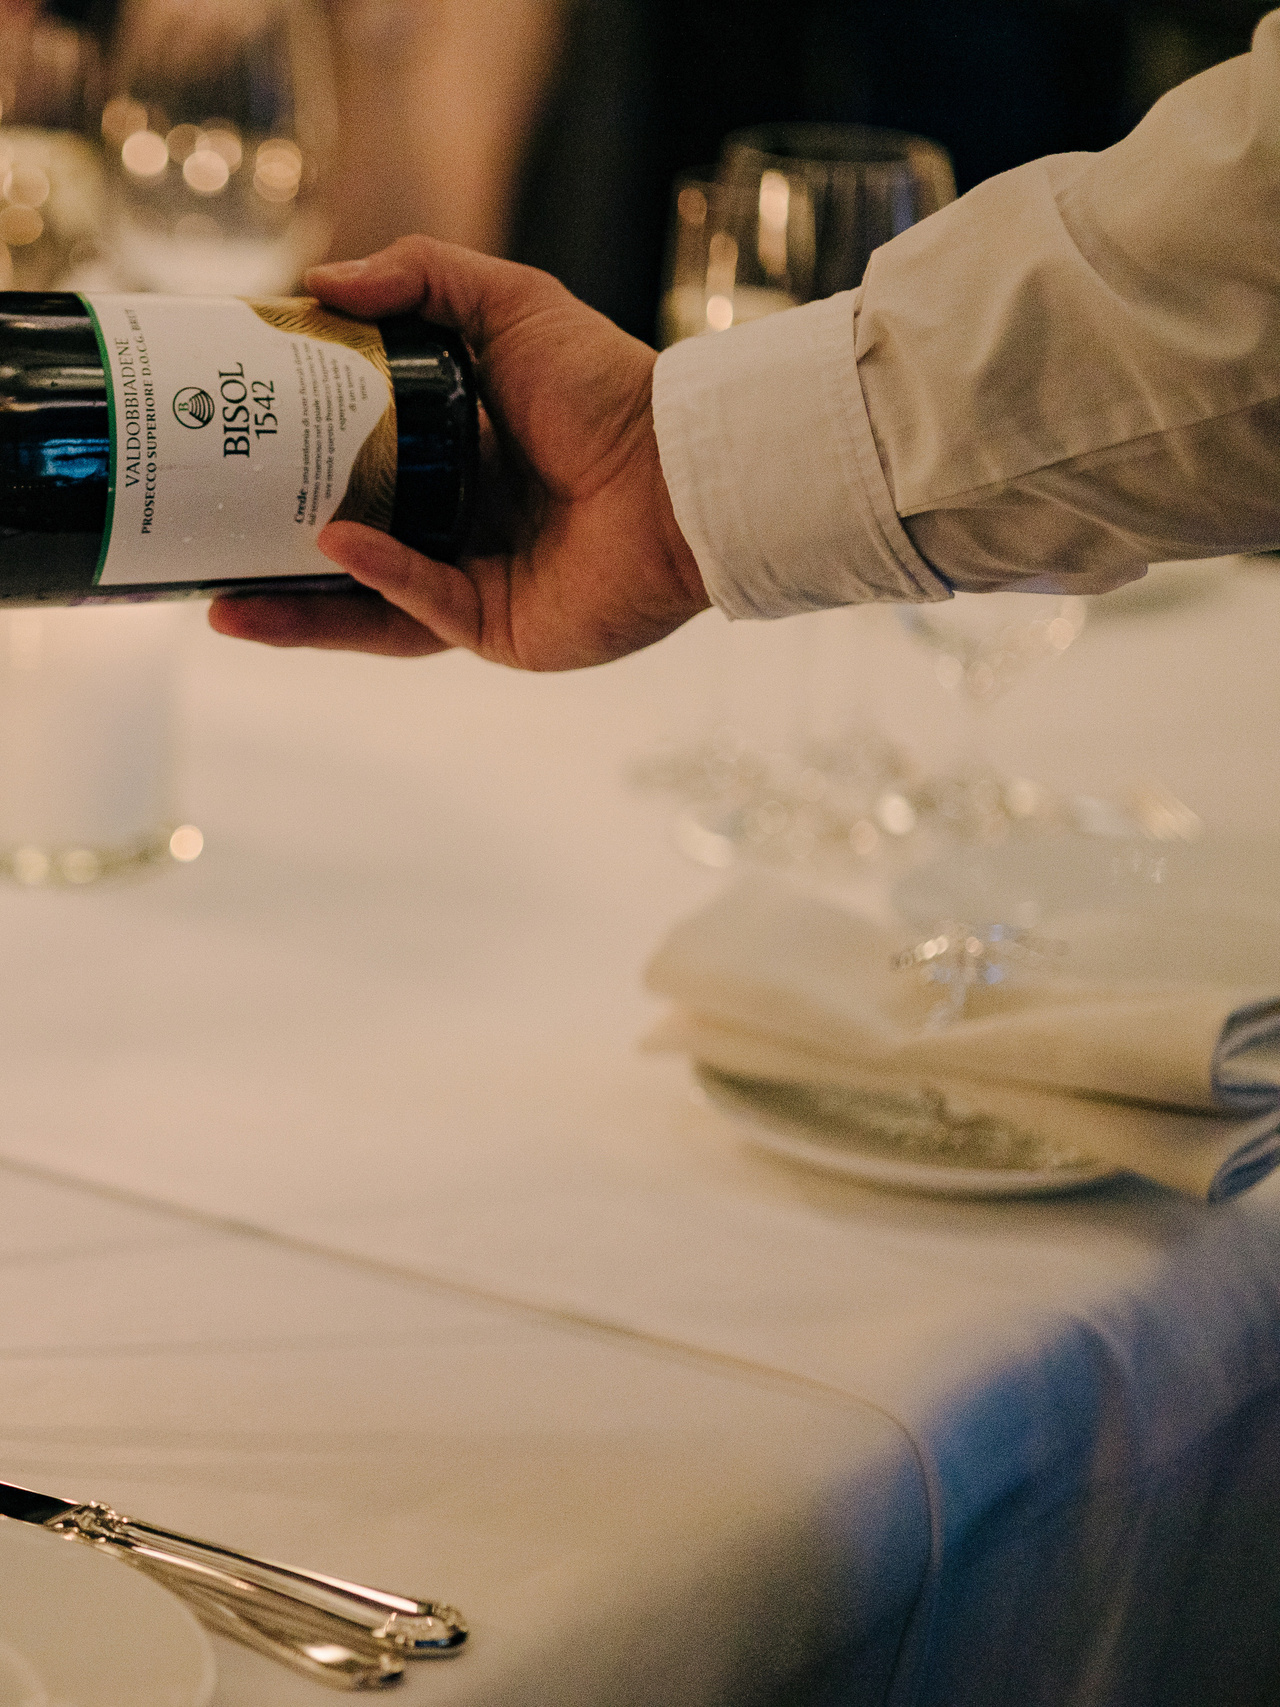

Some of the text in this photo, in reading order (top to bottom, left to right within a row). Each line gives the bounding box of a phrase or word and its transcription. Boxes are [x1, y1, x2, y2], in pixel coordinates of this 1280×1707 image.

[115, 337, 141, 488] VALDOBBIADENE
[143, 379, 158, 461] SUPERIORE
[218, 362, 250, 458] BISOL
[251, 380, 278, 439] 1542
[141, 463, 157, 534] PROSECCO
